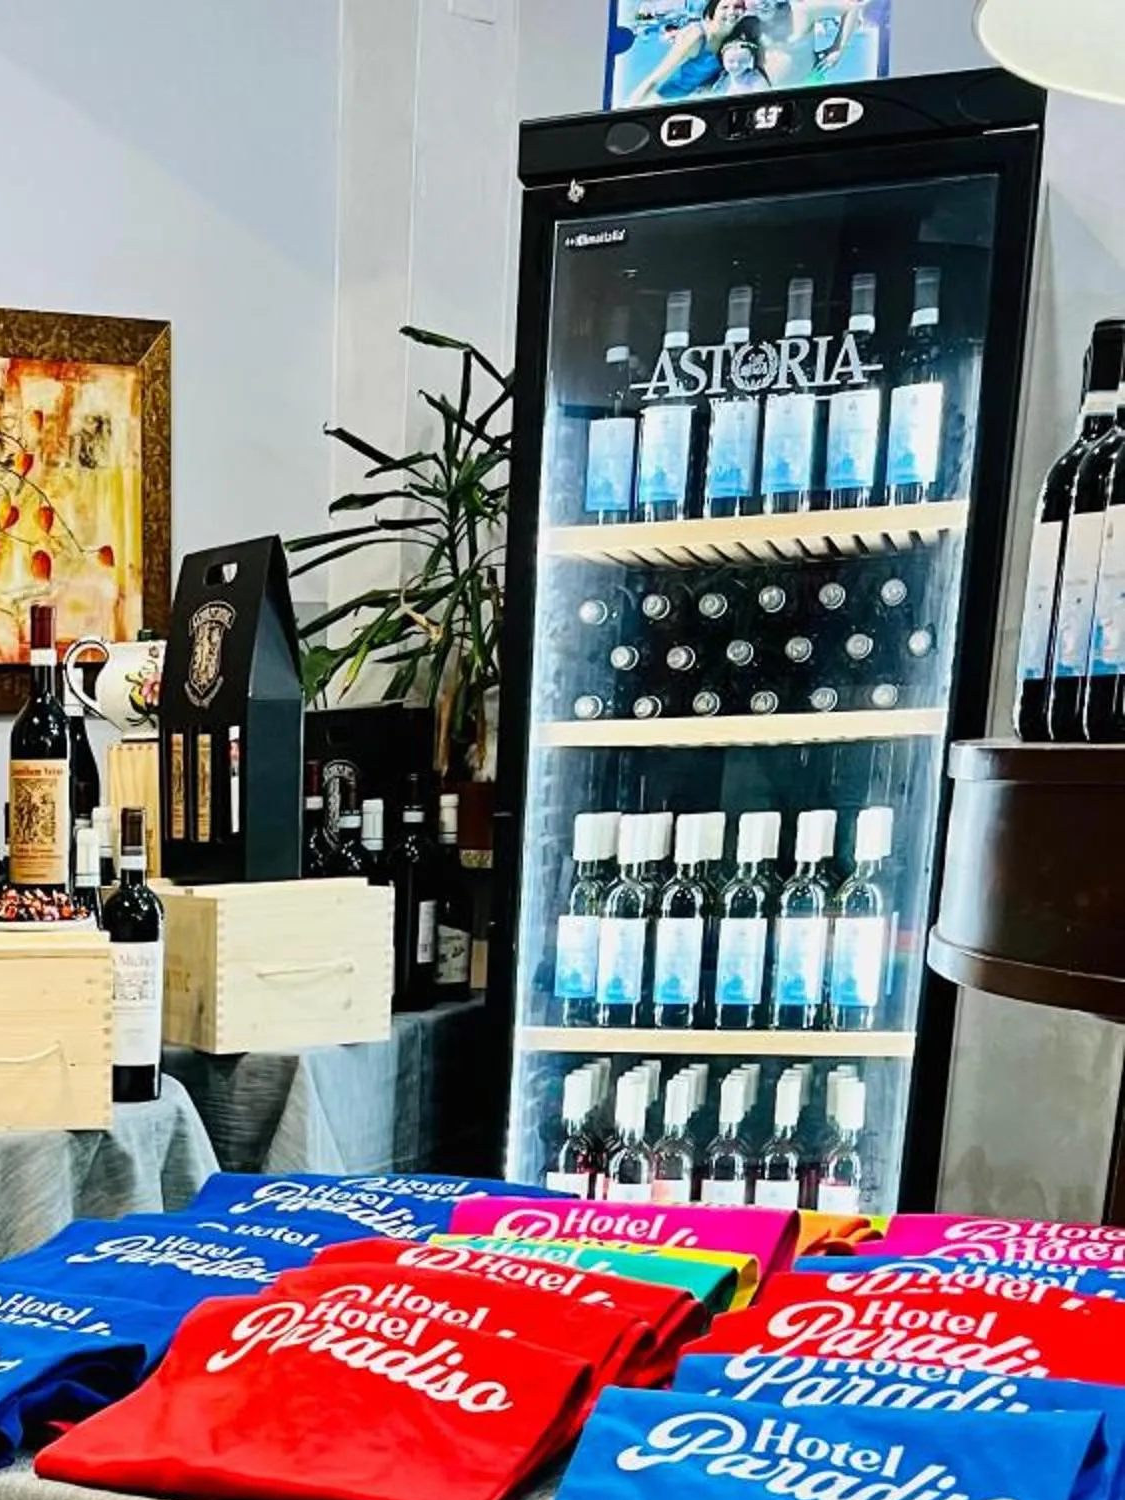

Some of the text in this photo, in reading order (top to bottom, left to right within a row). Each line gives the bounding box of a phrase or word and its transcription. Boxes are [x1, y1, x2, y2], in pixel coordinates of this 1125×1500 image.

[631, 333, 883, 400] ASTORIA
[309, 1185, 394, 1213] Hotel
[563, 1208, 667, 1240] Hotel
[1027, 1222, 1125, 1241] Hote
[156, 1235, 249, 1260] Hotel
[466, 1253, 586, 1295] Hotel
[0, 1293, 93, 1325] Hotel
[305, 1300, 429, 1347] Hotel
[371, 1283, 491, 1331] Hotel
[860, 1301, 998, 1340] Hotel
[206, 1301, 514, 1412] Paradiso
[753, 1418, 904, 1479] Hotel
